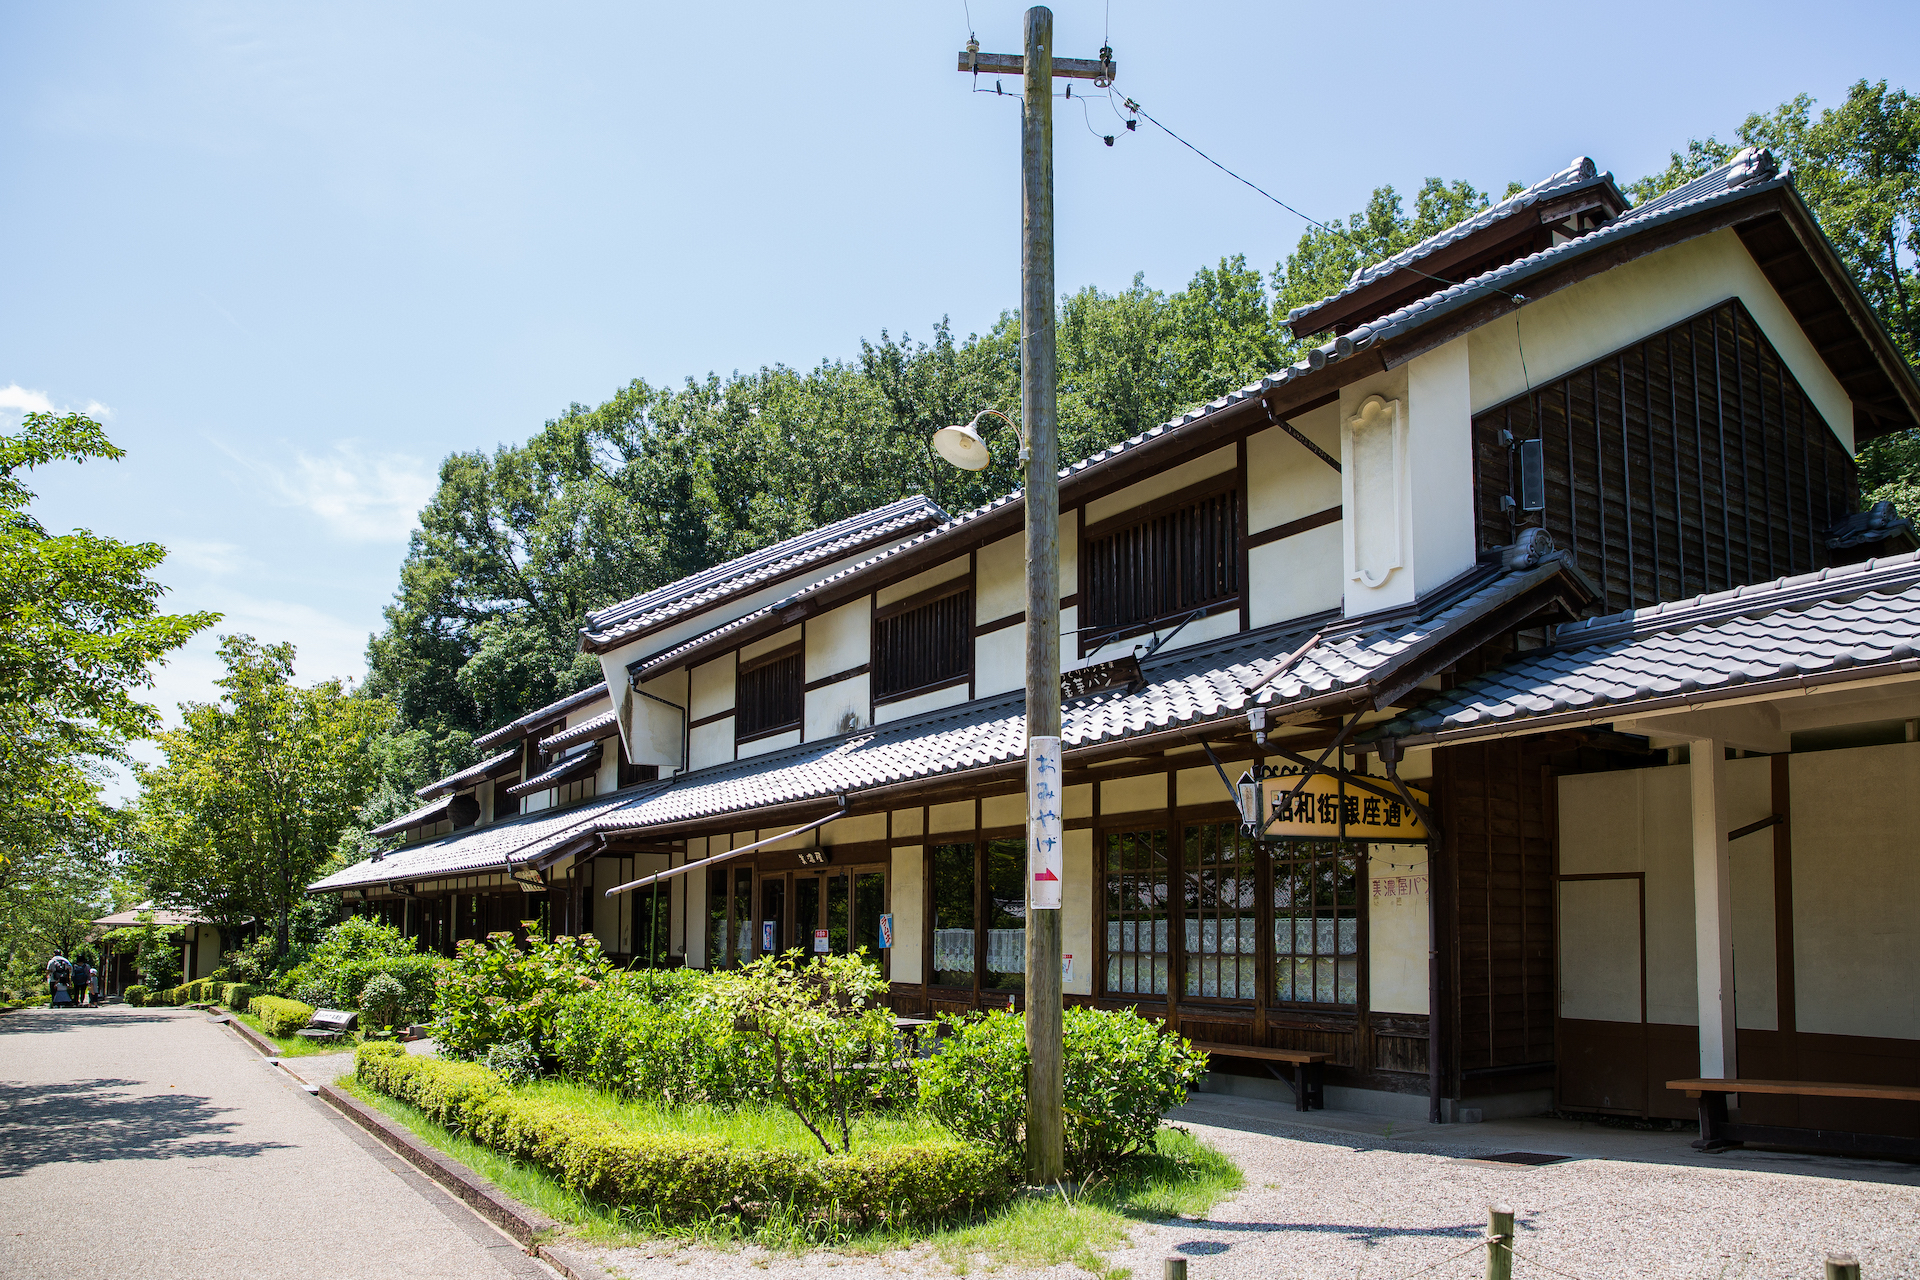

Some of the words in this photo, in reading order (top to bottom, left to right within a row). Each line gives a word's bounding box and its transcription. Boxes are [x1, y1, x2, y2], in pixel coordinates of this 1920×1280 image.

[1036, 754, 1057, 854] おみやげ
[1372, 876, 1429, 897] 美濃屋パン
